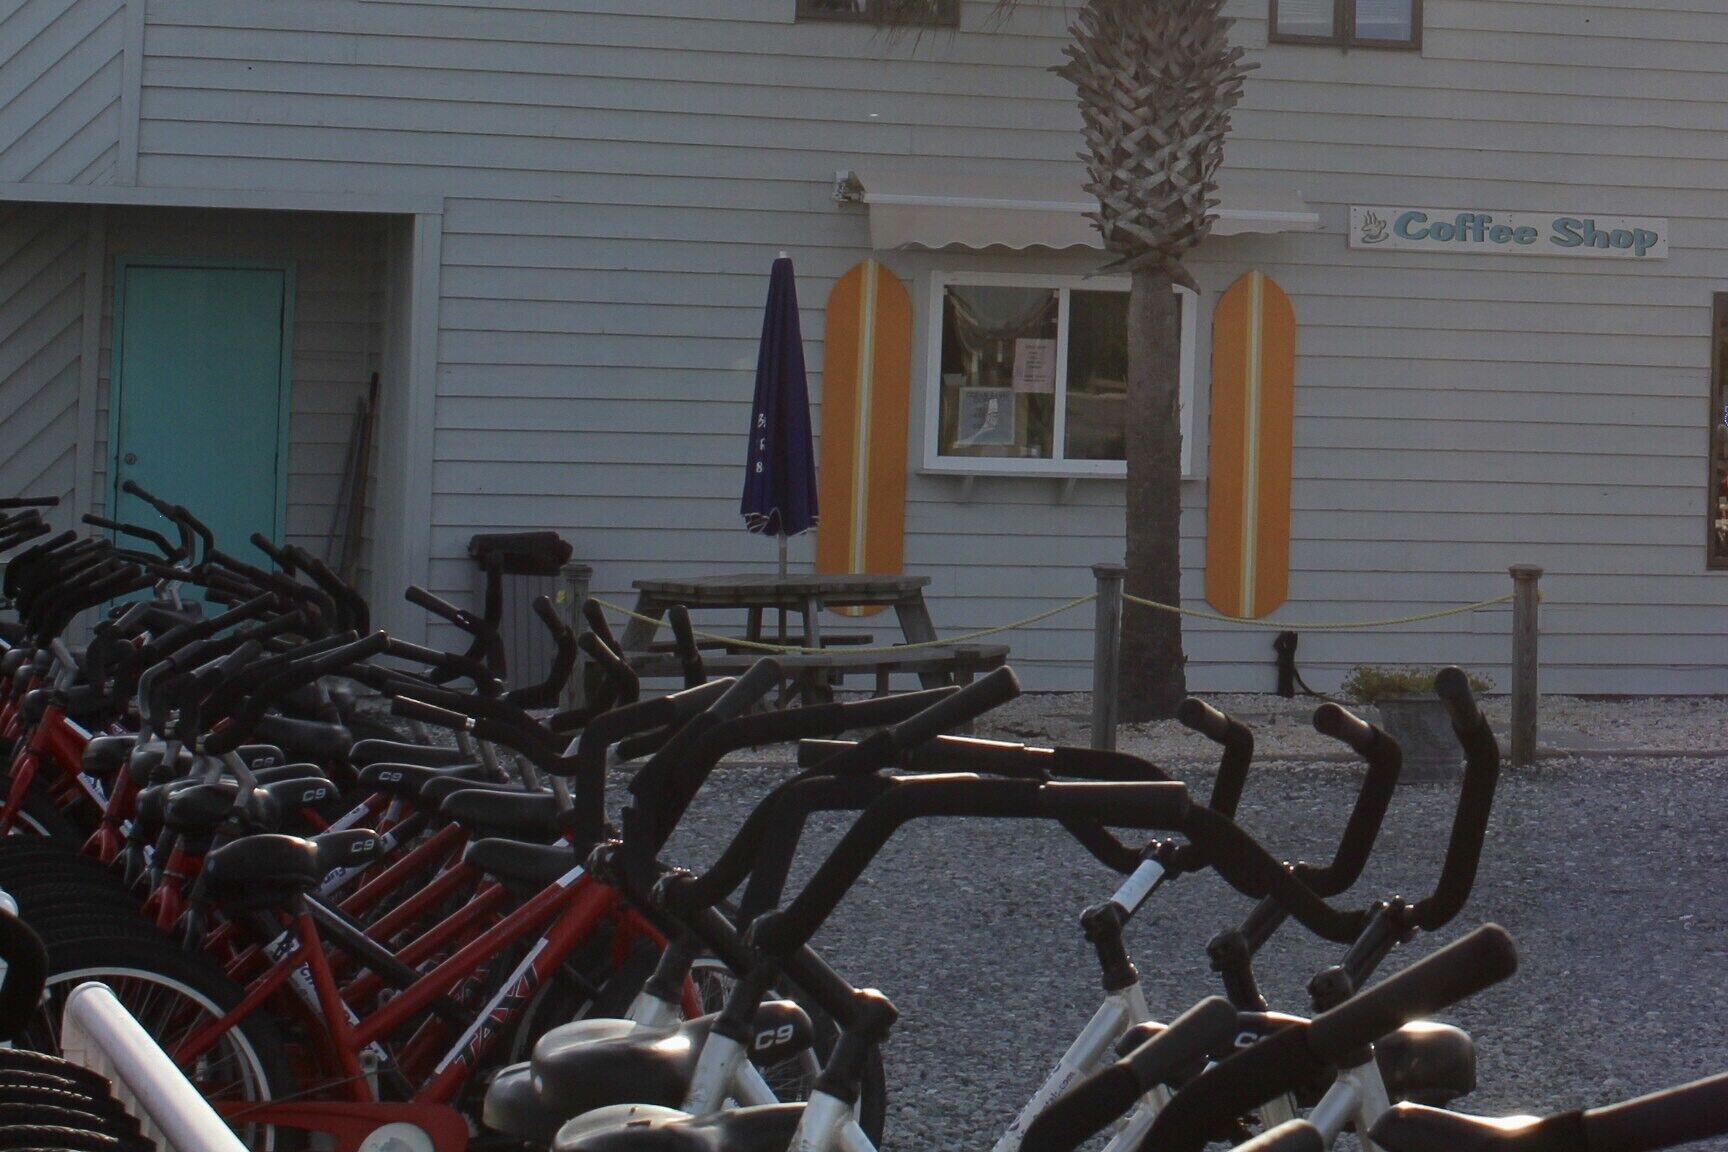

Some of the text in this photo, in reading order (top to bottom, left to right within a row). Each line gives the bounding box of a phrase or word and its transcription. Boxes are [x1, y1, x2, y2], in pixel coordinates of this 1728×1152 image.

[1393, 210, 1659, 256] Coffee Shop
[378, 771, 403, 782] C9
[302, 788, 326, 802] C9
[351, 838, 375, 853] C9
[754, 1023, 794, 1051] C9
[1234, 1032, 1270, 1048] C
